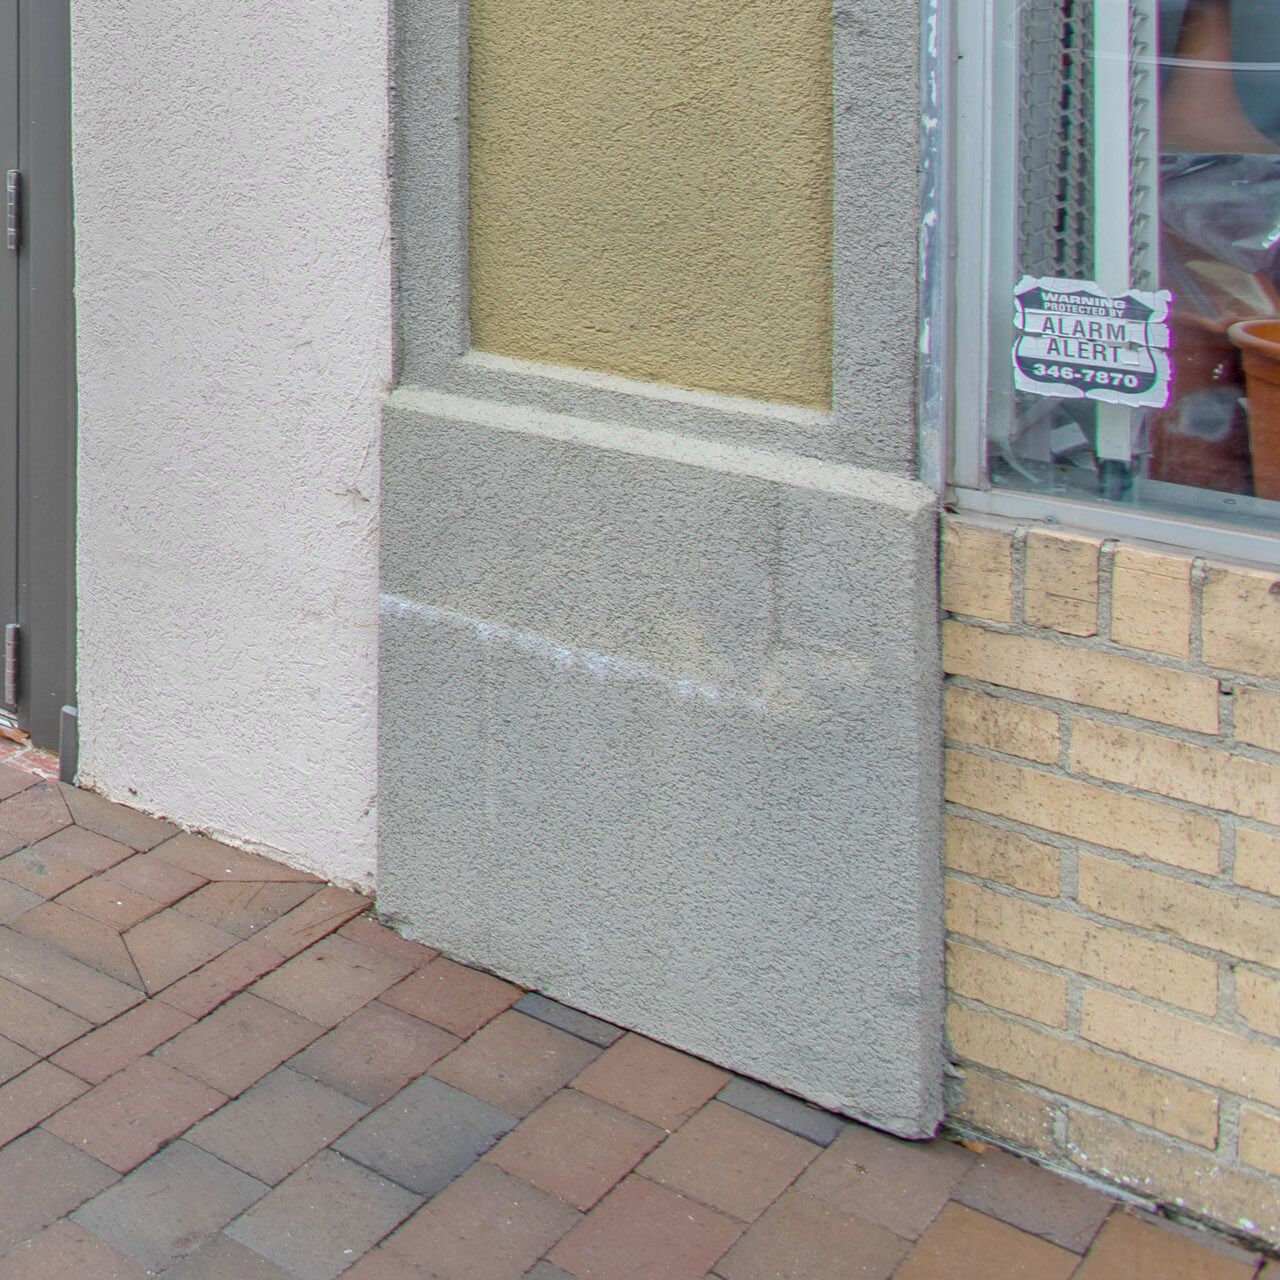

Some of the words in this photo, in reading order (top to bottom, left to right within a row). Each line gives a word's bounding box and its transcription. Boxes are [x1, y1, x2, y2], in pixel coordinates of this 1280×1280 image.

[1041, 292, 1128, 309] WARNING
[1044, 302, 1105, 316] PROTECTED
[1109, 308, 1124, 318] BY
[1042, 316, 1126, 341] ALARM
[1046, 338, 1120, 362] ALERT
[1032, 363, 1139, 388] 346-7870
